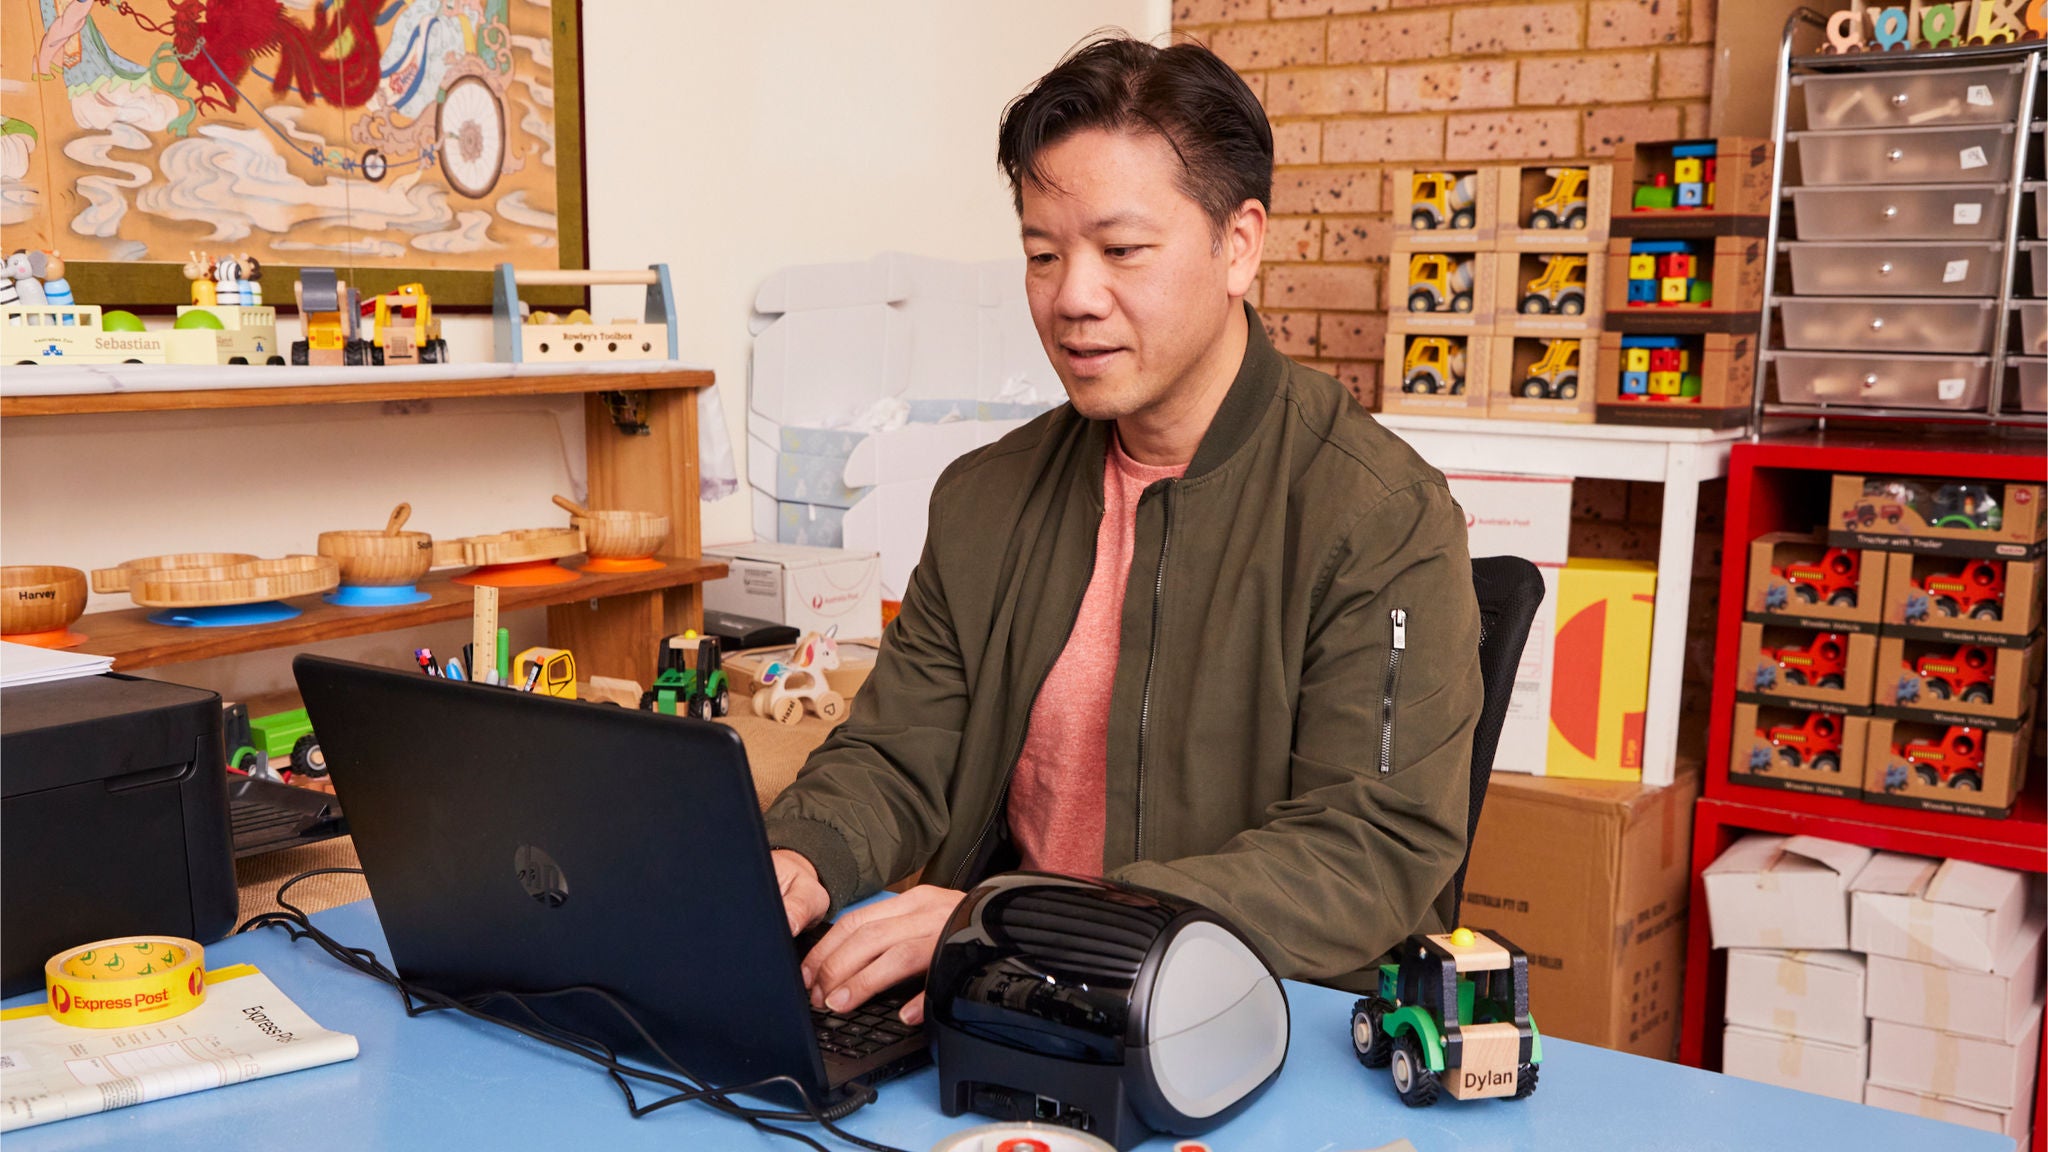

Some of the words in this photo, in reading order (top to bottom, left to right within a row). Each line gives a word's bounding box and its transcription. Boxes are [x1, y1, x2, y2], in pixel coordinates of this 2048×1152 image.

[95, 337, 161, 350] Sebastian
[563, 332, 597, 342] Rowley's
[600, 332, 632, 340] Toolbox
[1479, 518, 1511, 526] Australia
[1512, 519, 1531, 527] Post
[1856, 534, 1889, 545] Tractor
[1891, 537, 1910, 546] with
[1913, 538, 1943, 549] Trailer
[18, 590, 56, 601] Harvey
[1802, 620, 1831, 628] Wooden
[1833, 623, 1860, 631] Vehicle
[1943, 631, 1975, 641] Wooden
[1977, 634, 2007, 644] Vehicle
[781, 700, 796, 724] Hazel
[1790, 700, 1819, 709] Wooden
[1821, 703, 1848, 713] Vehicle
[1934, 713, 1966, 723] Wooden
[1968, 716, 1997, 726] Vehicle
[1784, 782, 1814, 792] Wooden
[1816, 785, 1843, 796] Vehicle
[1922, 802, 1953, 812] Wooden
[1956, 805, 1985, 816] Vehicle
[1467, 892, 1501, 909] AUSTRALIA
[1503, 898, 1515, 910] PTY
[1517, 901, 1528, 913] LTD
[1538, 955, 1562, 970] ROLLER
[74, 995, 133, 1013] Express
[135, 988, 169, 1007] Post
[242, 1005, 282, 1039] Express
[1464, 1070, 1513, 1091] Dylan
